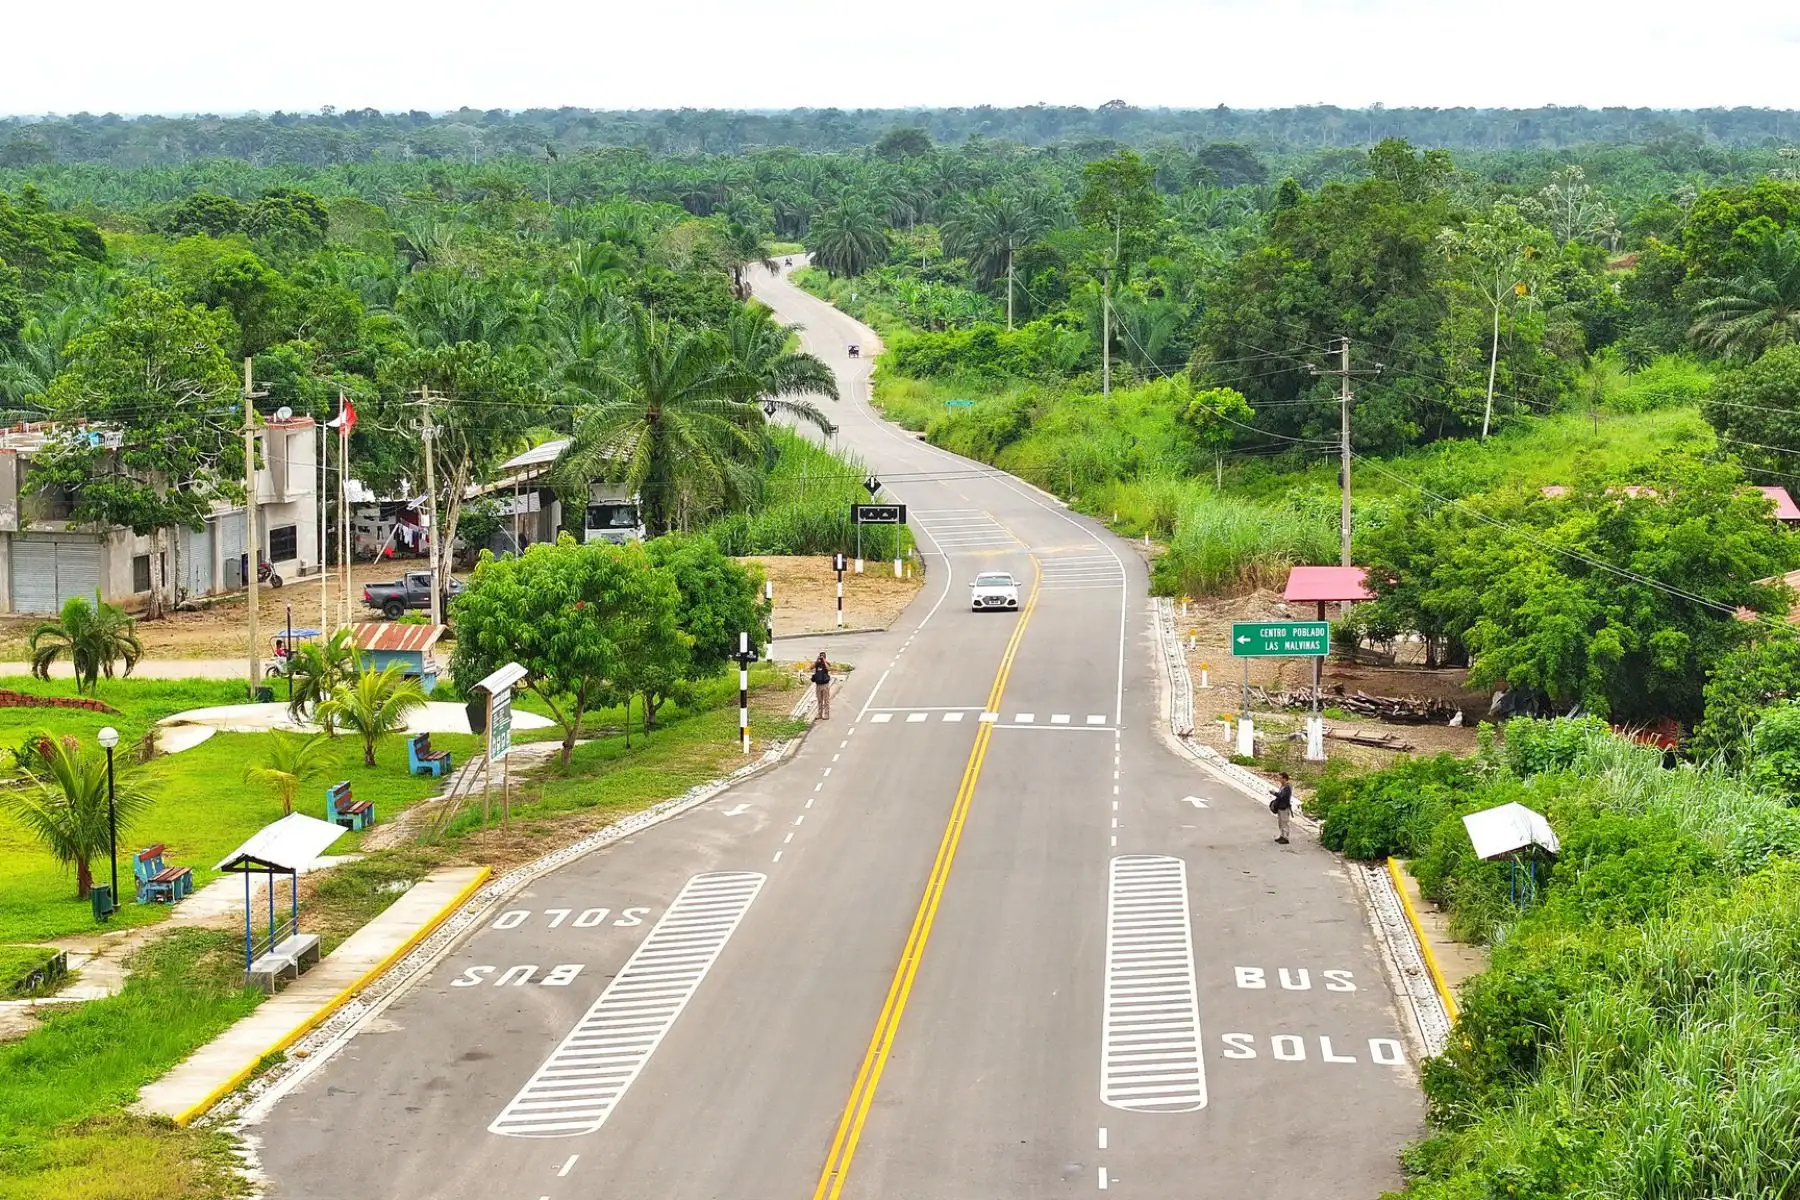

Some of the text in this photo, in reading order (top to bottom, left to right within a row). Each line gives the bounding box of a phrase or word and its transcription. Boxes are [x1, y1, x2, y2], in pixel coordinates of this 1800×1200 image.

[1260, 627, 1325, 637] CENTRO POBLADO
[1265, 641, 1321, 651] LAS MALVINAS
[491, 907, 651, 929] SOLO
[450, 964, 585, 986] BUS
[1234, 966, 1357, 992] BUS
[1221, 1032, 1406, 1065] SOLO
